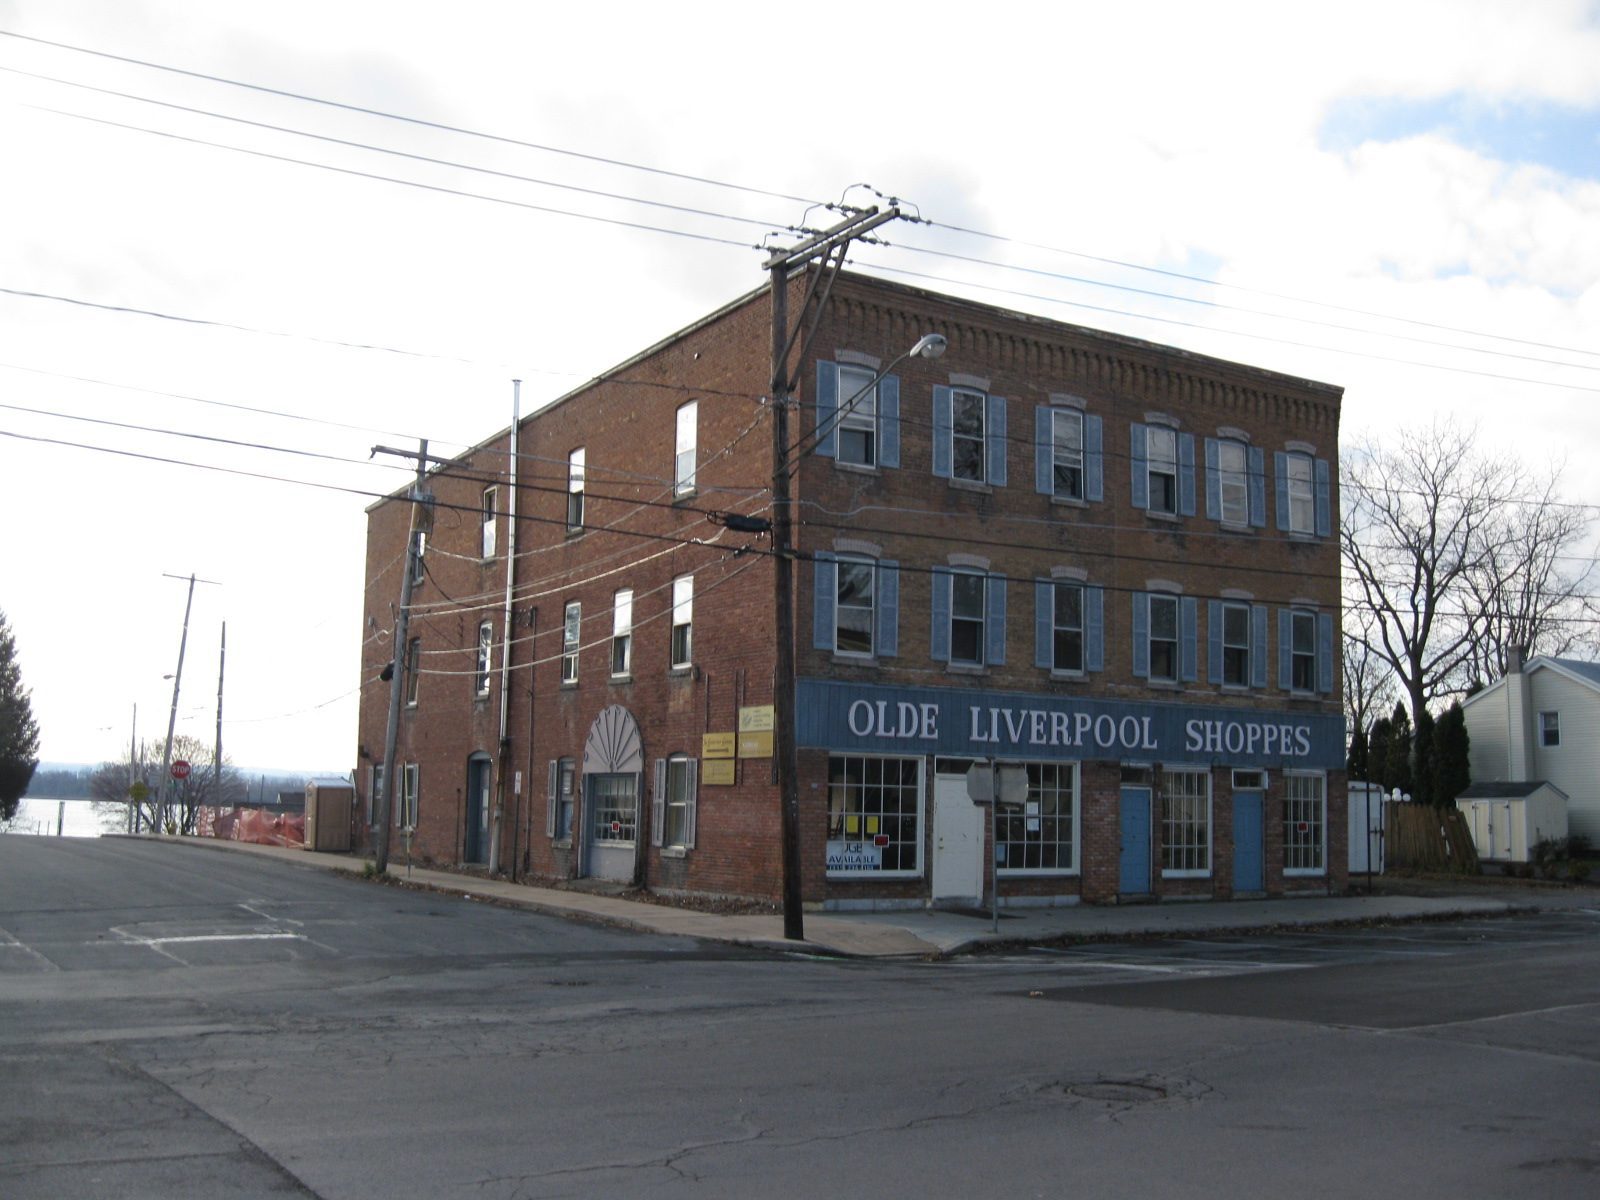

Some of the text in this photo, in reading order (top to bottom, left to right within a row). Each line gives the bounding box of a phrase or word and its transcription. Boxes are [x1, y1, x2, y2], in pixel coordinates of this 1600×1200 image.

[849, 700, 1311, 756] OLDE LIVERPOOL SHOPPES
[172, 765, 189, 774] STOP
